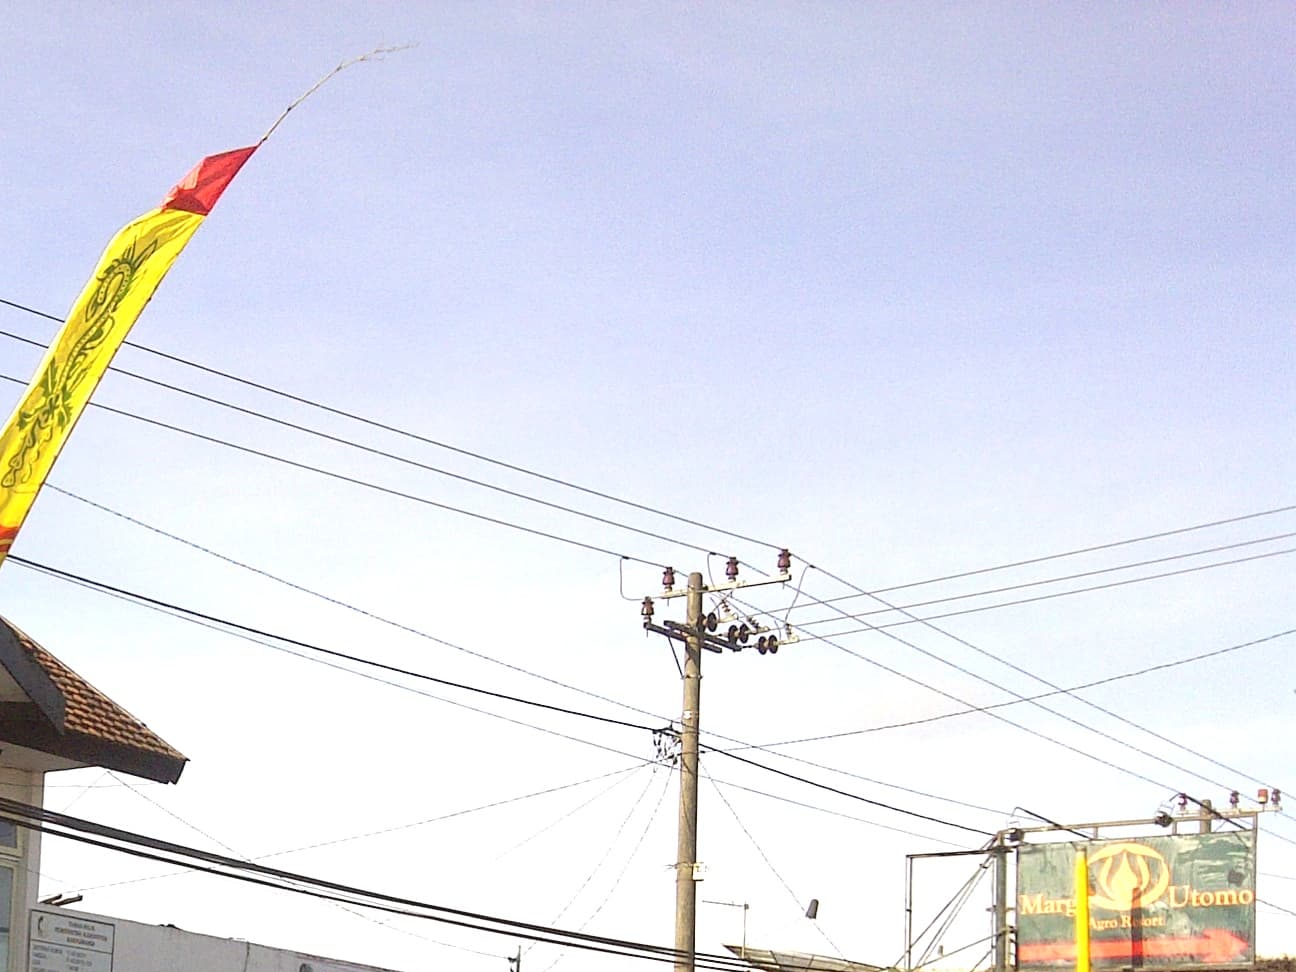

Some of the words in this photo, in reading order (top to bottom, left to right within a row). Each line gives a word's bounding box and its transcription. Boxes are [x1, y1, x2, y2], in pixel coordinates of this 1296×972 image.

[1020, 894, 1077, 916] Marg
[1169, 885, 1253, 908] Utomo
[1088, 917, 1118, 931] Agro
